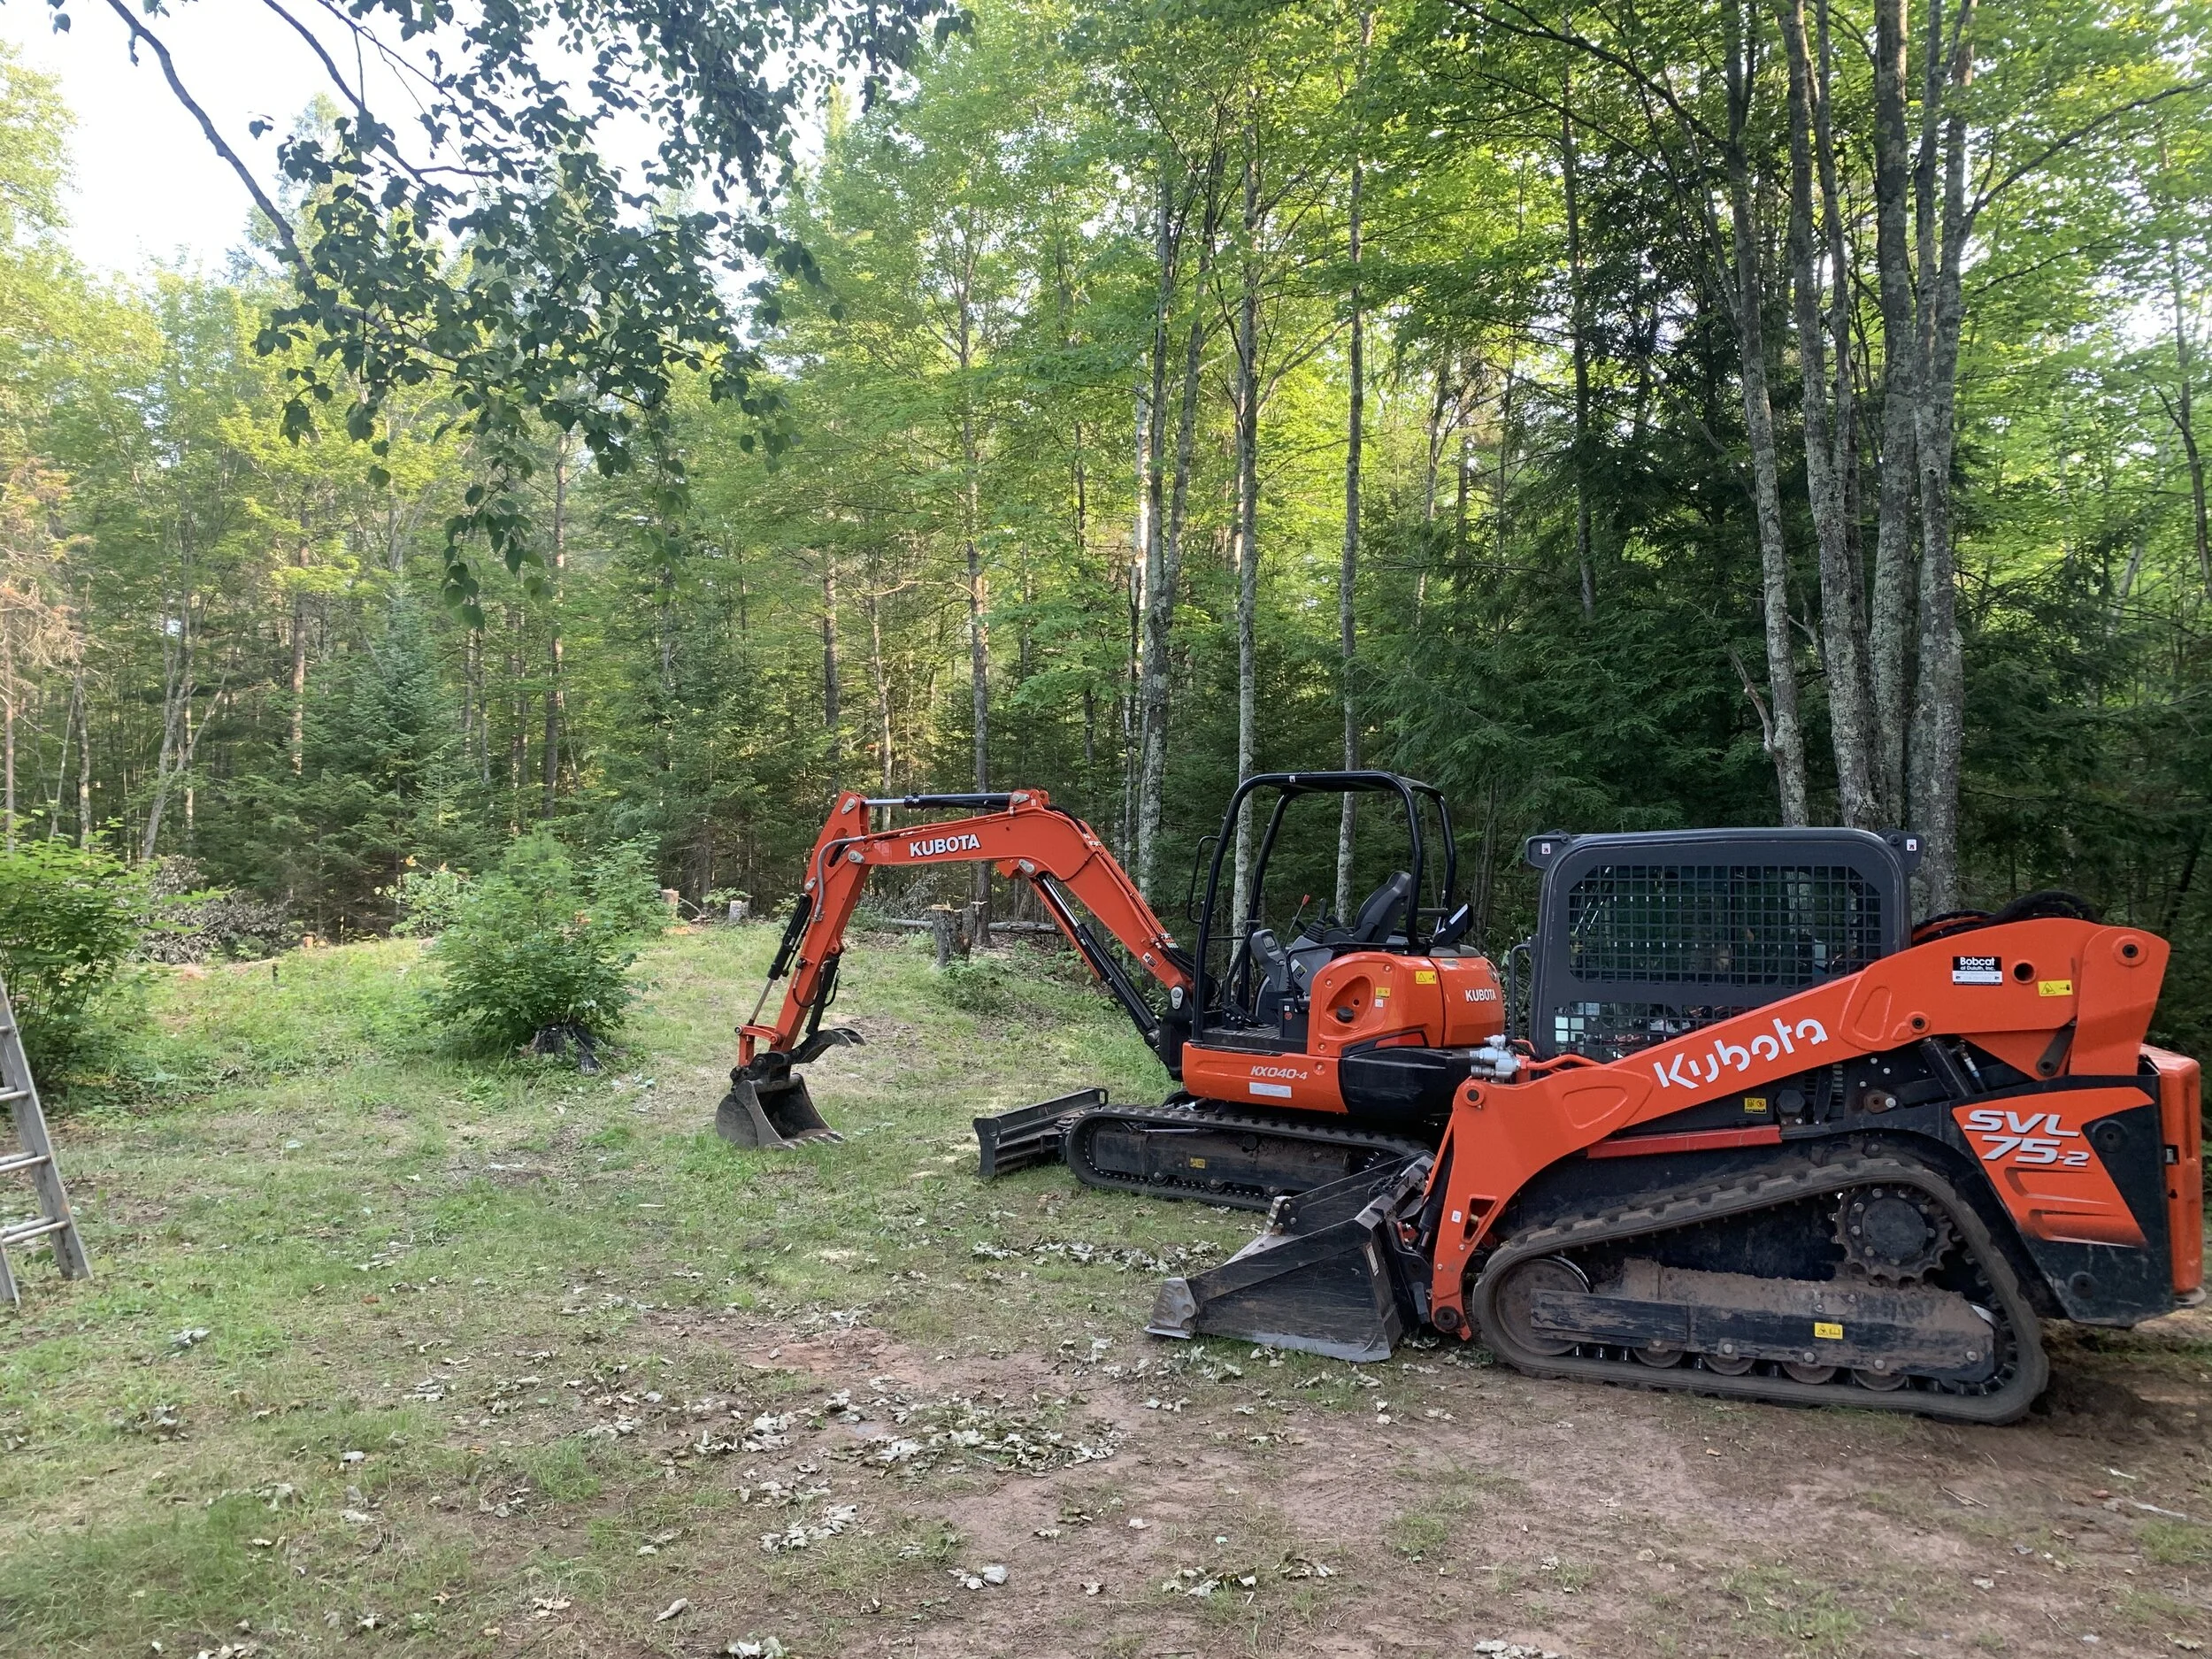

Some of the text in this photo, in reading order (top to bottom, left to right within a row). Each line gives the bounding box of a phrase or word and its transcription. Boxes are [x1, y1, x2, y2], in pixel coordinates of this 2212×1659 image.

[910, 833, 981, 857] KUBOTA
[1960, 956, 1995, 965] Bobcat
[1465, 988, 1497, 1002] KUBOTA
[1653, 1018, 1829, 1089] Kubota
[1250, 1065, 1309, 1080] KX040-4
[1963, 1109, 2080, 1138] SVL
[1981, 1134, 2090, 1167] 75-2
